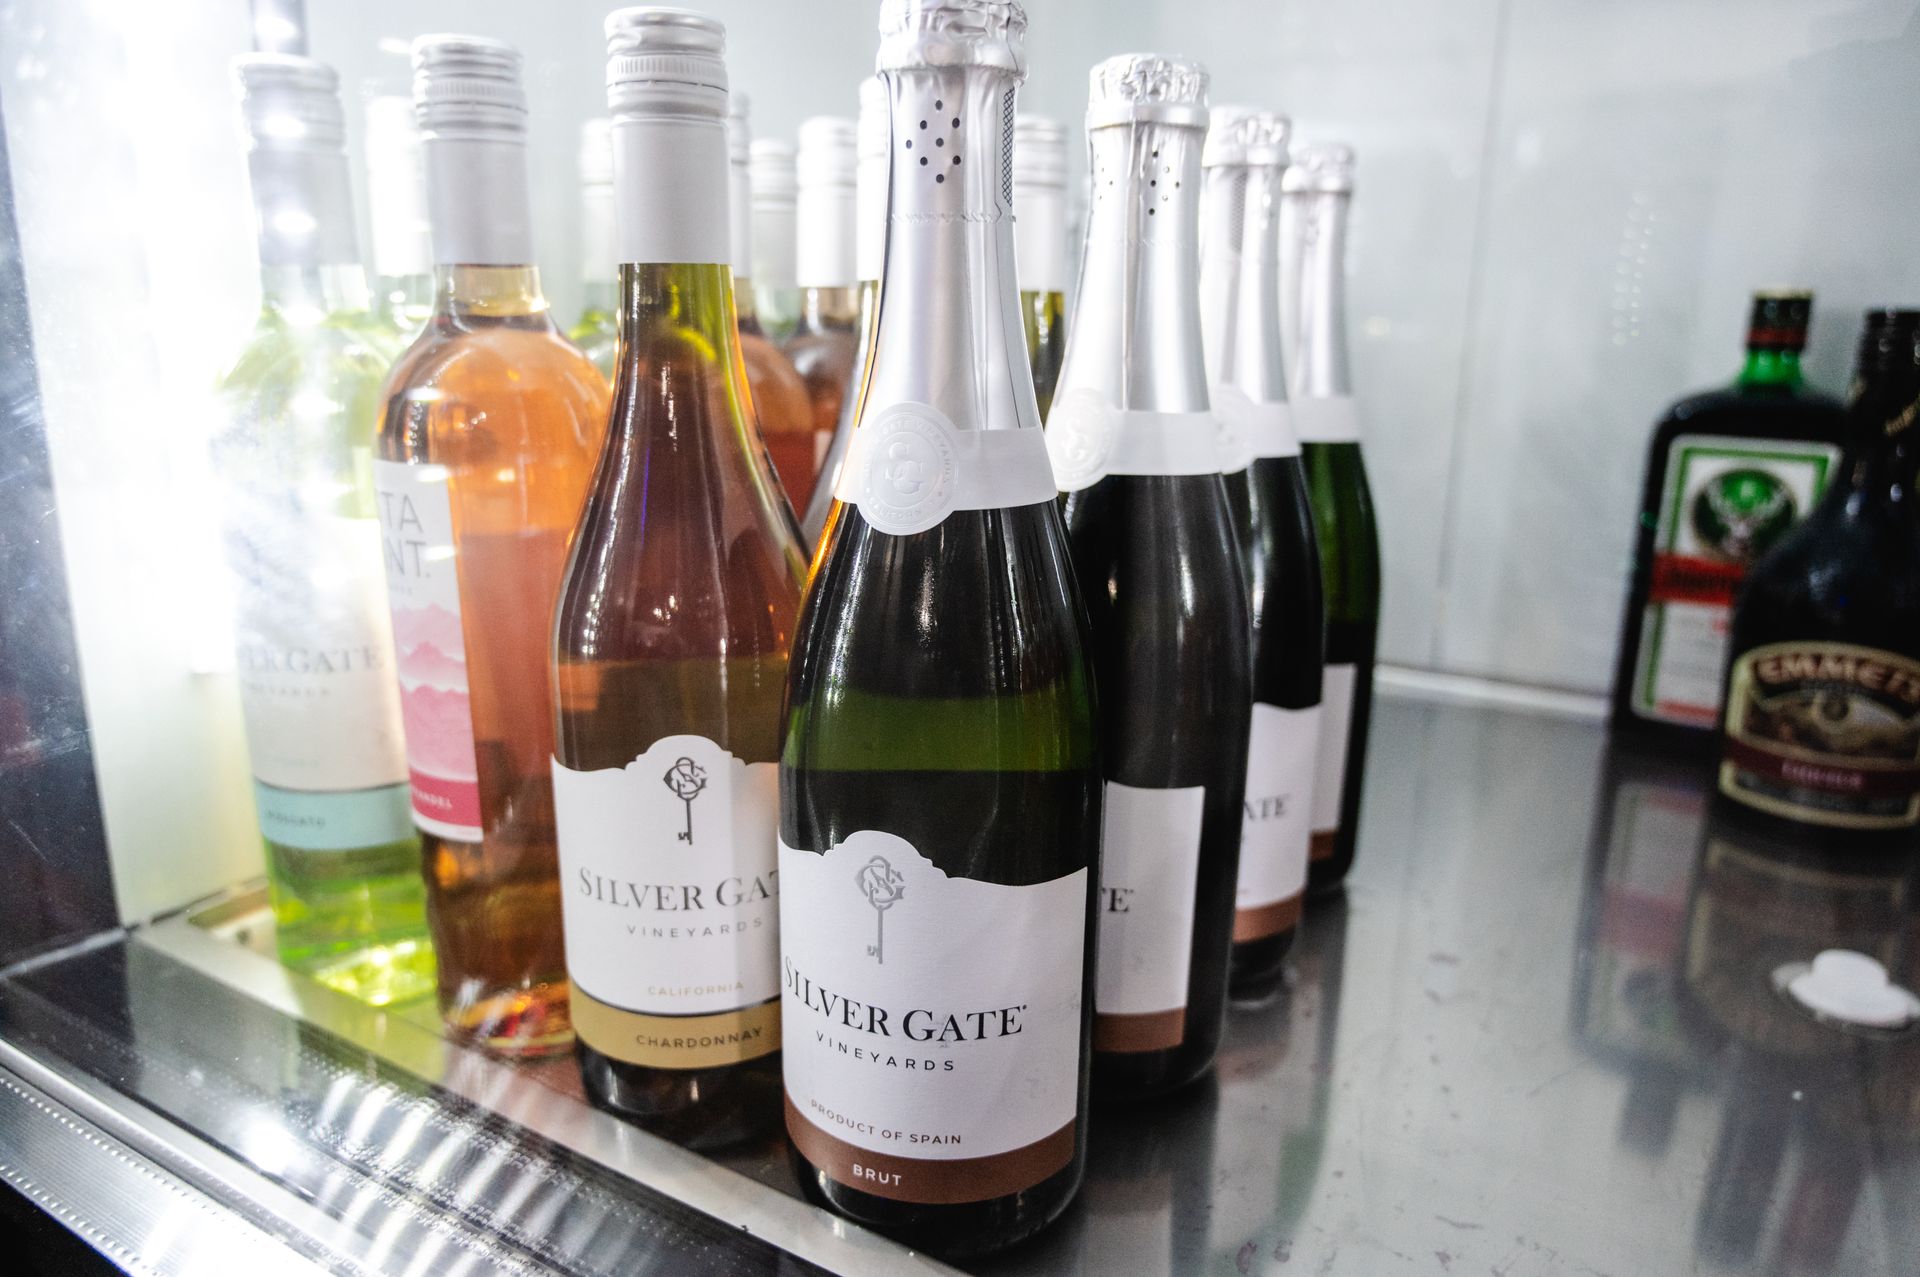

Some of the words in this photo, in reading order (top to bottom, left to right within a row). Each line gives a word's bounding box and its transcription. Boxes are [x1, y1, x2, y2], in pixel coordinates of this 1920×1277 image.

[579, 866, 705, 912] SILVER
[627, 917, 763, 939] VINEYARDS
[648, 981, 744, 997] CALIFORNIA
[784, 955, 892, 1037] SILVER
[636, 1027, 763, 1049] CHARDONNAY
[816, 1030, 955, 1072] VINEYARDS
[811, 1098, 875, 1136] PRODUCT
[881, 1128, 904, 1141] OF
[909, 1132, 962, 1145] SPAIN
[852, 1163, 902, 1187] BRUT
